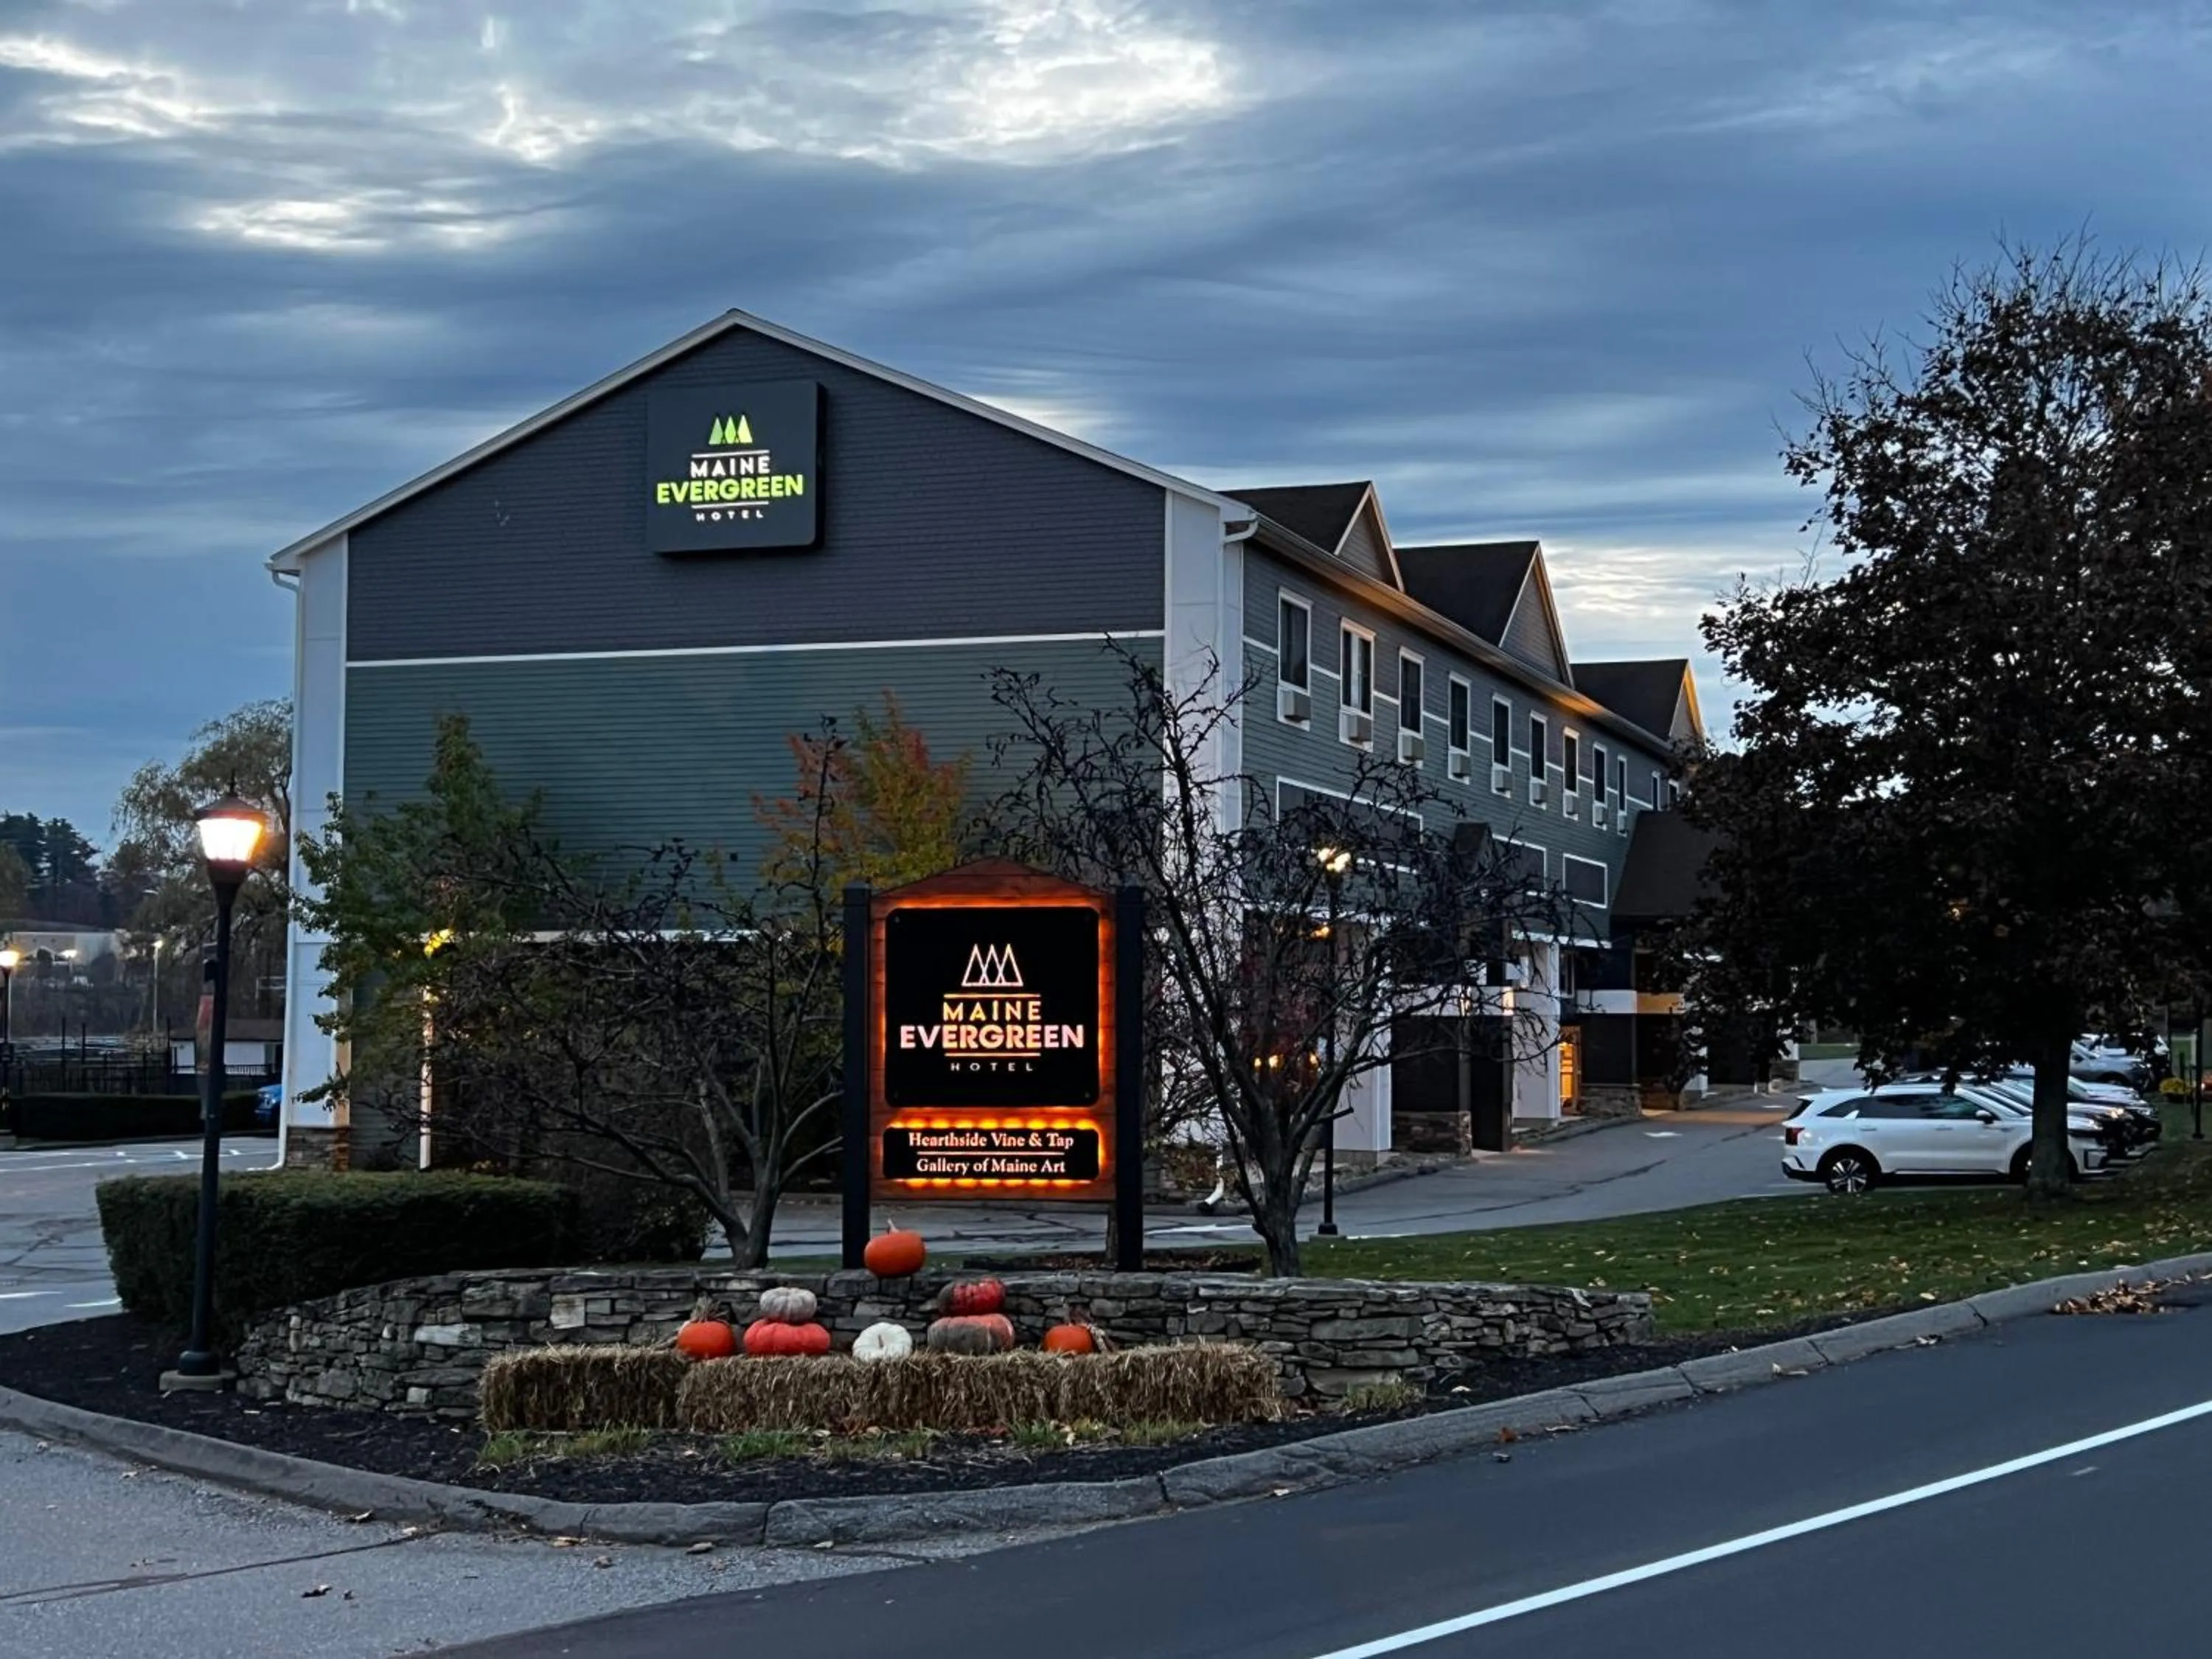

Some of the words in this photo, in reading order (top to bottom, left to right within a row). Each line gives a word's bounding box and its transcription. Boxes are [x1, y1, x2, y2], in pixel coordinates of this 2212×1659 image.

[690, 456, 770, 478] MAINE
[657, 474, 804, 504] EVERGREEN
[695, 509, 764, 521] HOTEL
[942, 1000, 1041, 1021] MAINE
[900, 1024, 1084, 1048] EVERGREEN
[950, 1062, 1034, 1071] HOTEL
[908, 1132, 987, 1147] Hearthside
[991, 1133, 1025, 1147] Vine
[1029, 1133, 1043, 1147] &
[1046, 1133, 1074, 1149] Tap
[917, 1158, 969, 1175] Gallery
[973, 1158, 991, 1172] of
[991, 1158, 1037, 1172] Maine
[1040, 1159, 1066, 1172] Art
